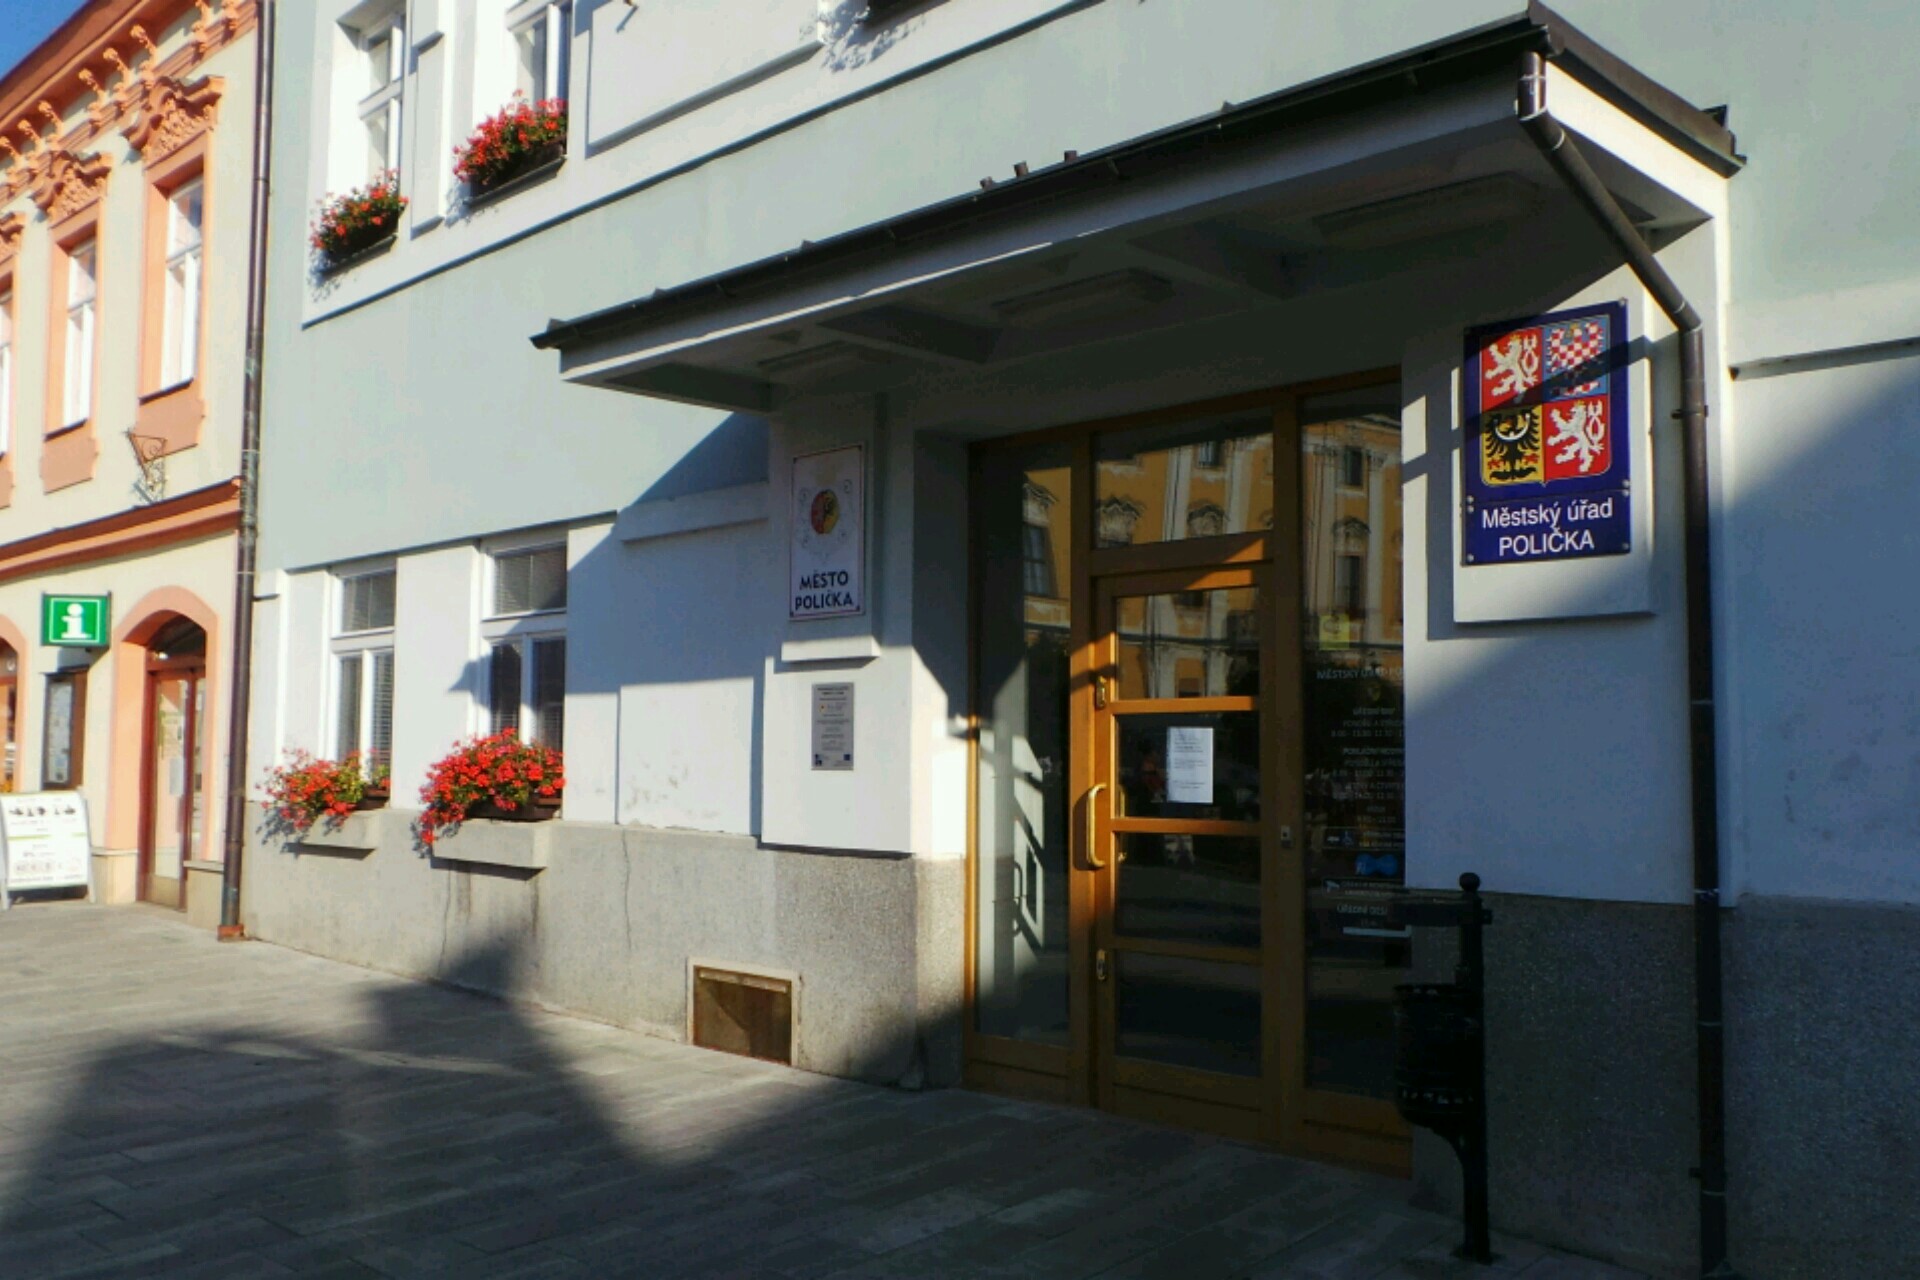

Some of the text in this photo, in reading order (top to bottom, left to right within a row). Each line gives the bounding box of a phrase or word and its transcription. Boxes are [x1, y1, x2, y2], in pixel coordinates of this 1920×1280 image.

[1482, 497, 1613, 529] Městský úřad
[1499, 528, 1595, 556] POLIČKA
[799, 570, 849, 590] MĚSTO
[795, 590, 854, 611] POLIČKA
